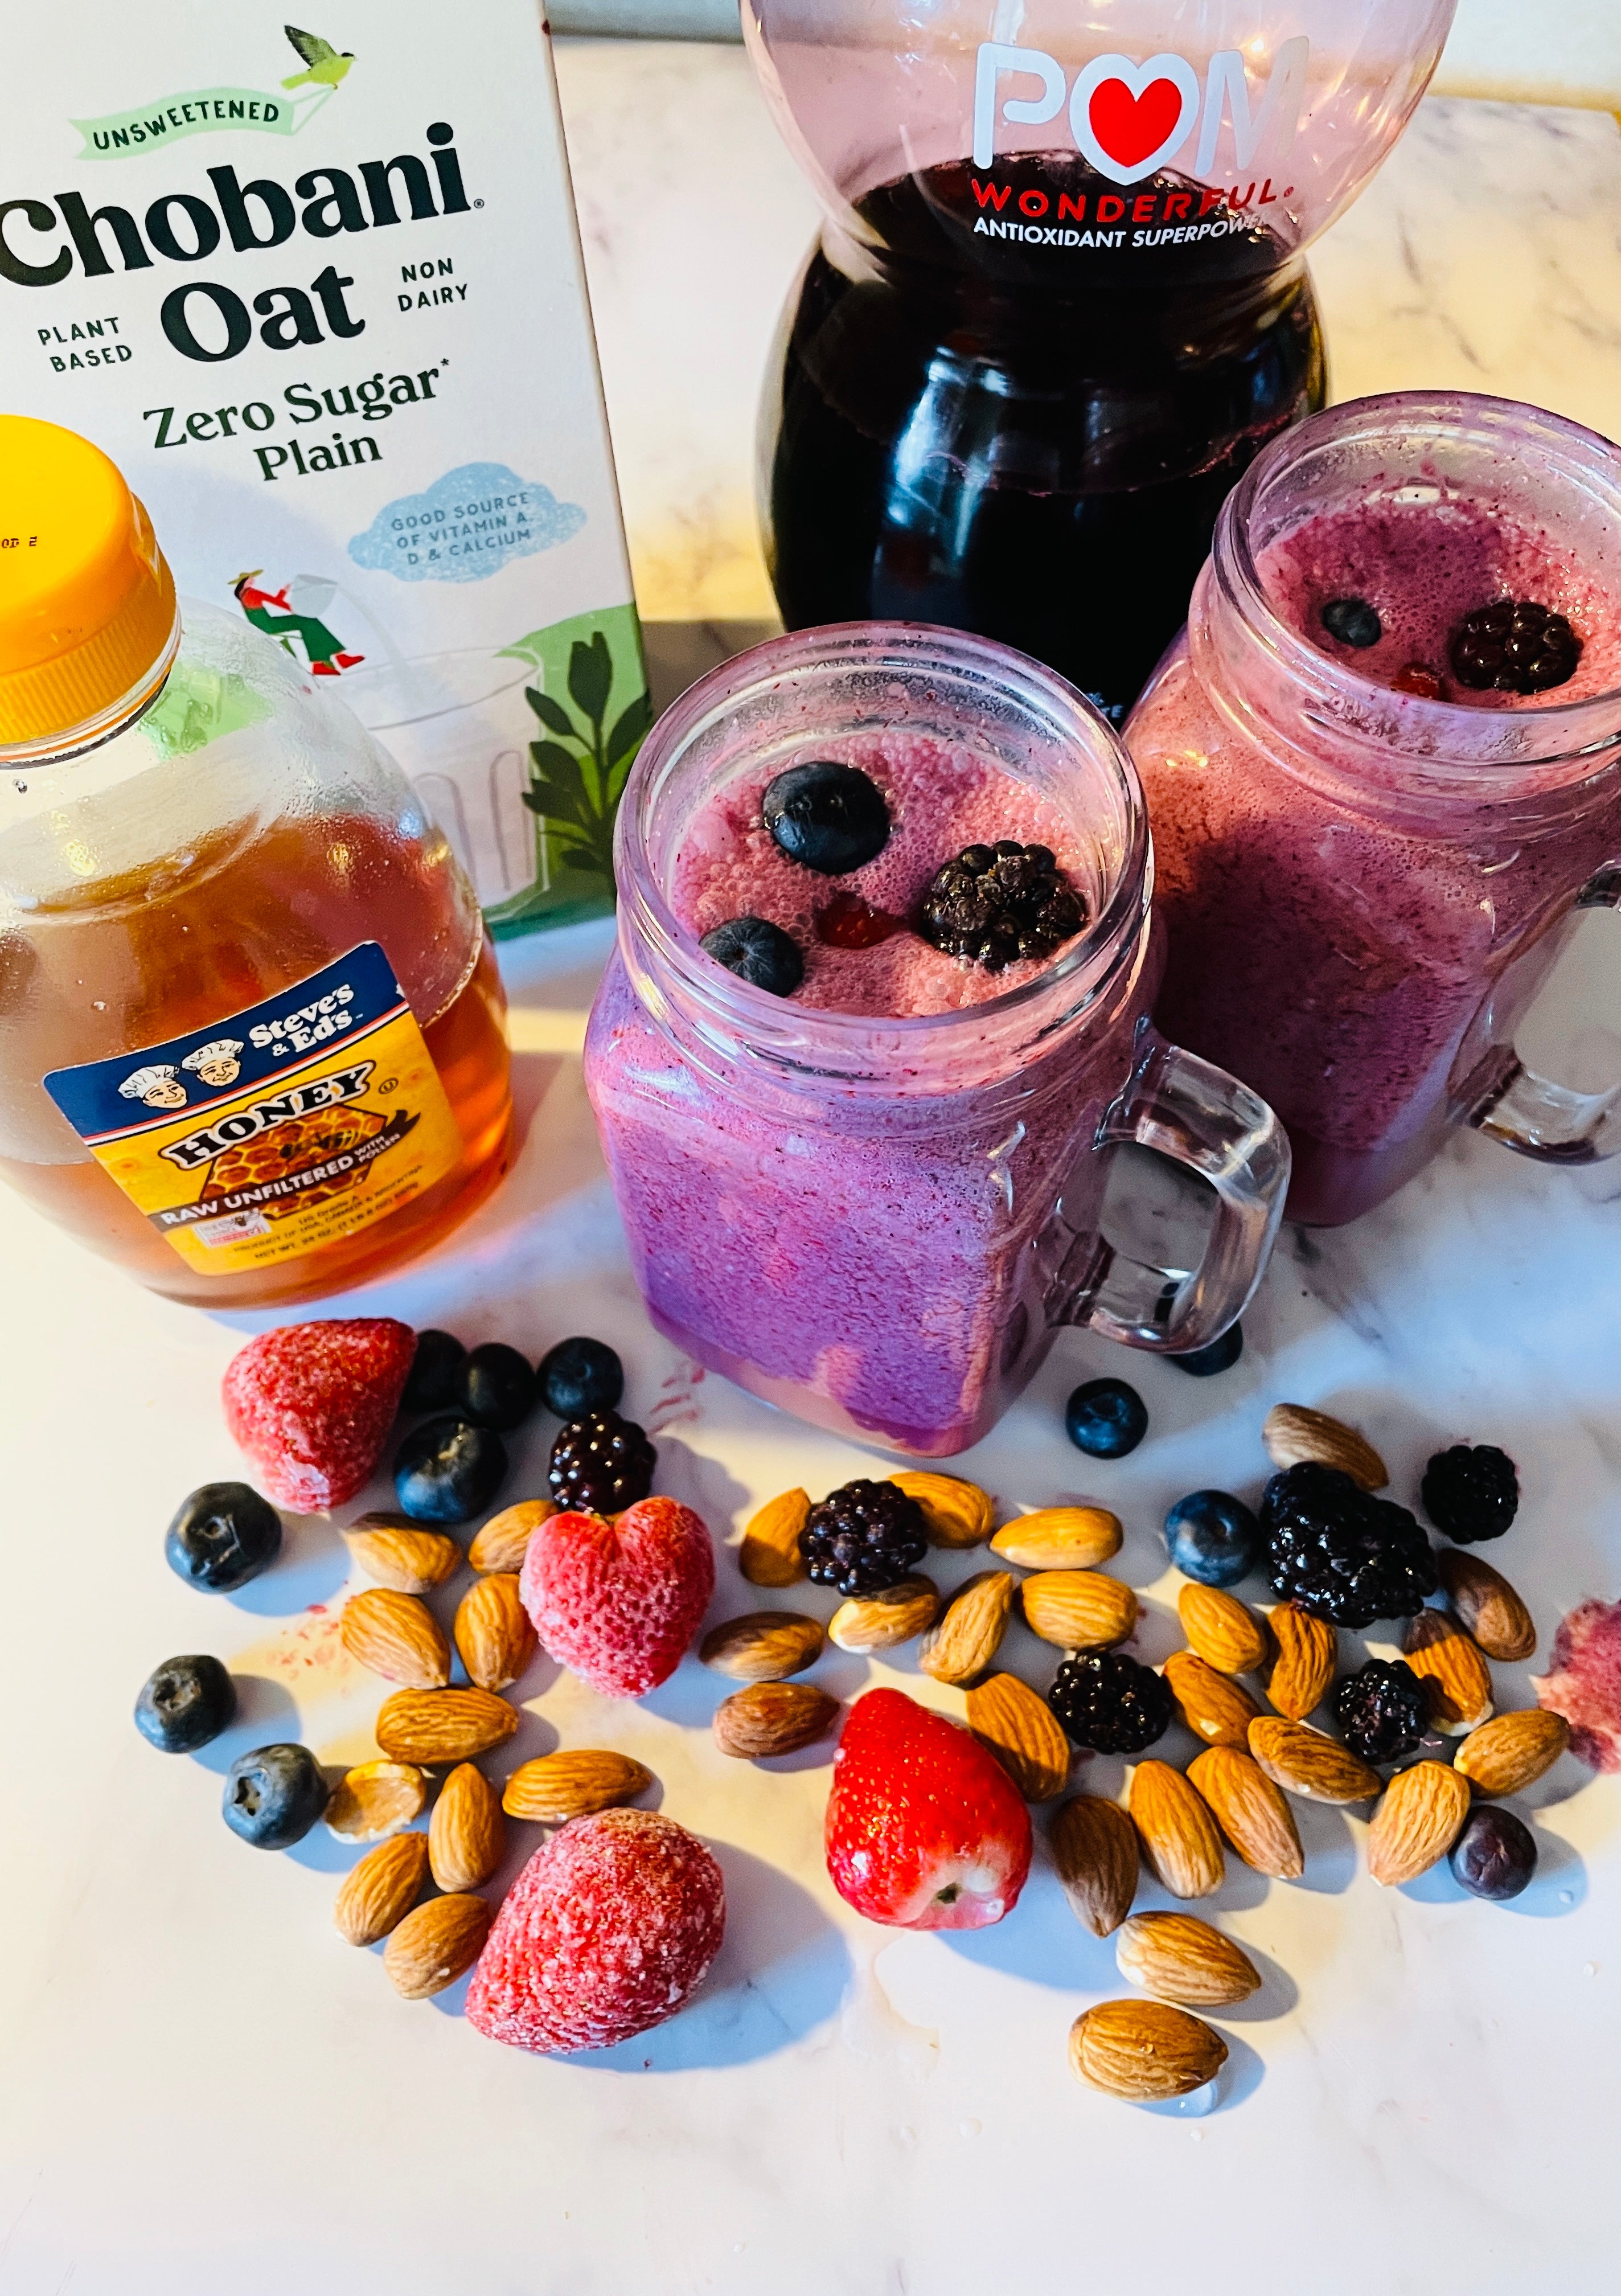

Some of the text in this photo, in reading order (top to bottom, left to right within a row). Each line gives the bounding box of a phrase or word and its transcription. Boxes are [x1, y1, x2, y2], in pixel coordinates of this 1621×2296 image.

[93, 100, 280, 150] UNSWEETENED
[973, 35, 1309, 185] POM
[973, 217, 1126, 248] ANTIOXIDANT
[401, 258, 453, 282] NON
[160, 265, 365, 362] Oat
[398, 284, 469, 312] DAIRY
[38, 317, 121, 345] PLANT
[50, 344, 132, 372] BASED
[143, 400, 275, 449] Zero
[253, 432, 383, 482] Plain
[391, 492, 528, 531] GOOD SOURCE
[397, 534, 419, 549] OF
[429, 514, 507, 542] VITAMIN
[407, 529, 531, 565] D & CALCIUM
[249, 983, 354, 1048] Steve's
[272, 1010, 352, 1057] & Ed's
[169, 1067, 368, 1165] HONEY
[161, 1198, 217, 1224] RAW
[224, 1155, 354, 1209] UNFILTERED
